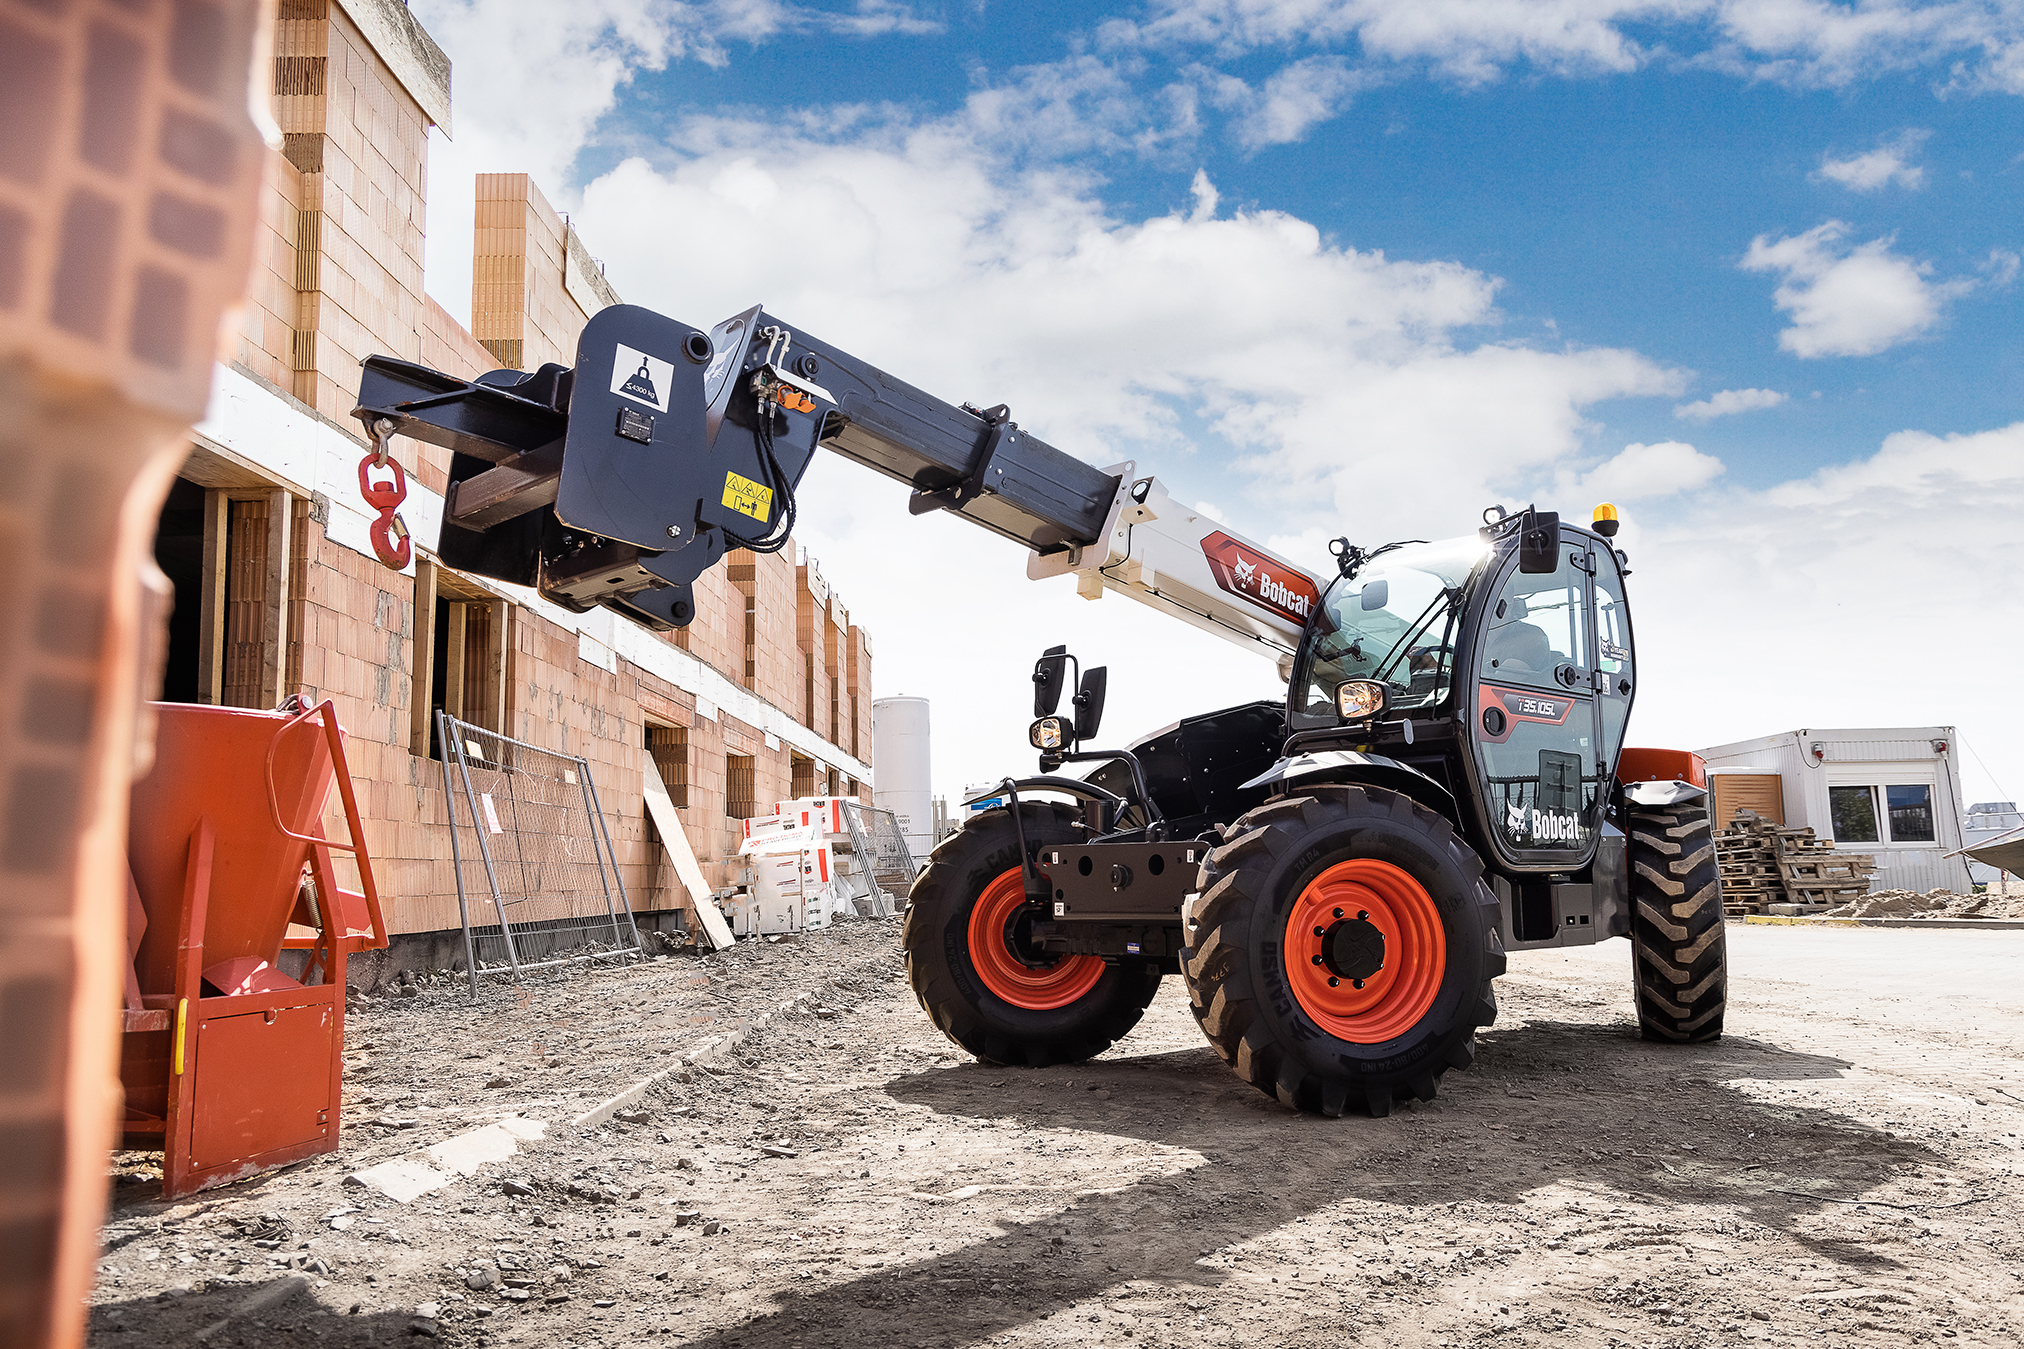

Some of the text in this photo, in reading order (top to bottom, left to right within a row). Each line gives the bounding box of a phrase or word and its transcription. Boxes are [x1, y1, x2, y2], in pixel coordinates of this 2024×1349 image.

[647, 389, 655, 399] kg
[1260, 572, 1309, 618] Bobcat
[1532, 809, 1579, 840] Bobcat
[1294, 848, 1320, 872] TM R4
[1261, 942, 1292, 1018] CAMSO
[1361, 1062, 1376, 1073] IND
